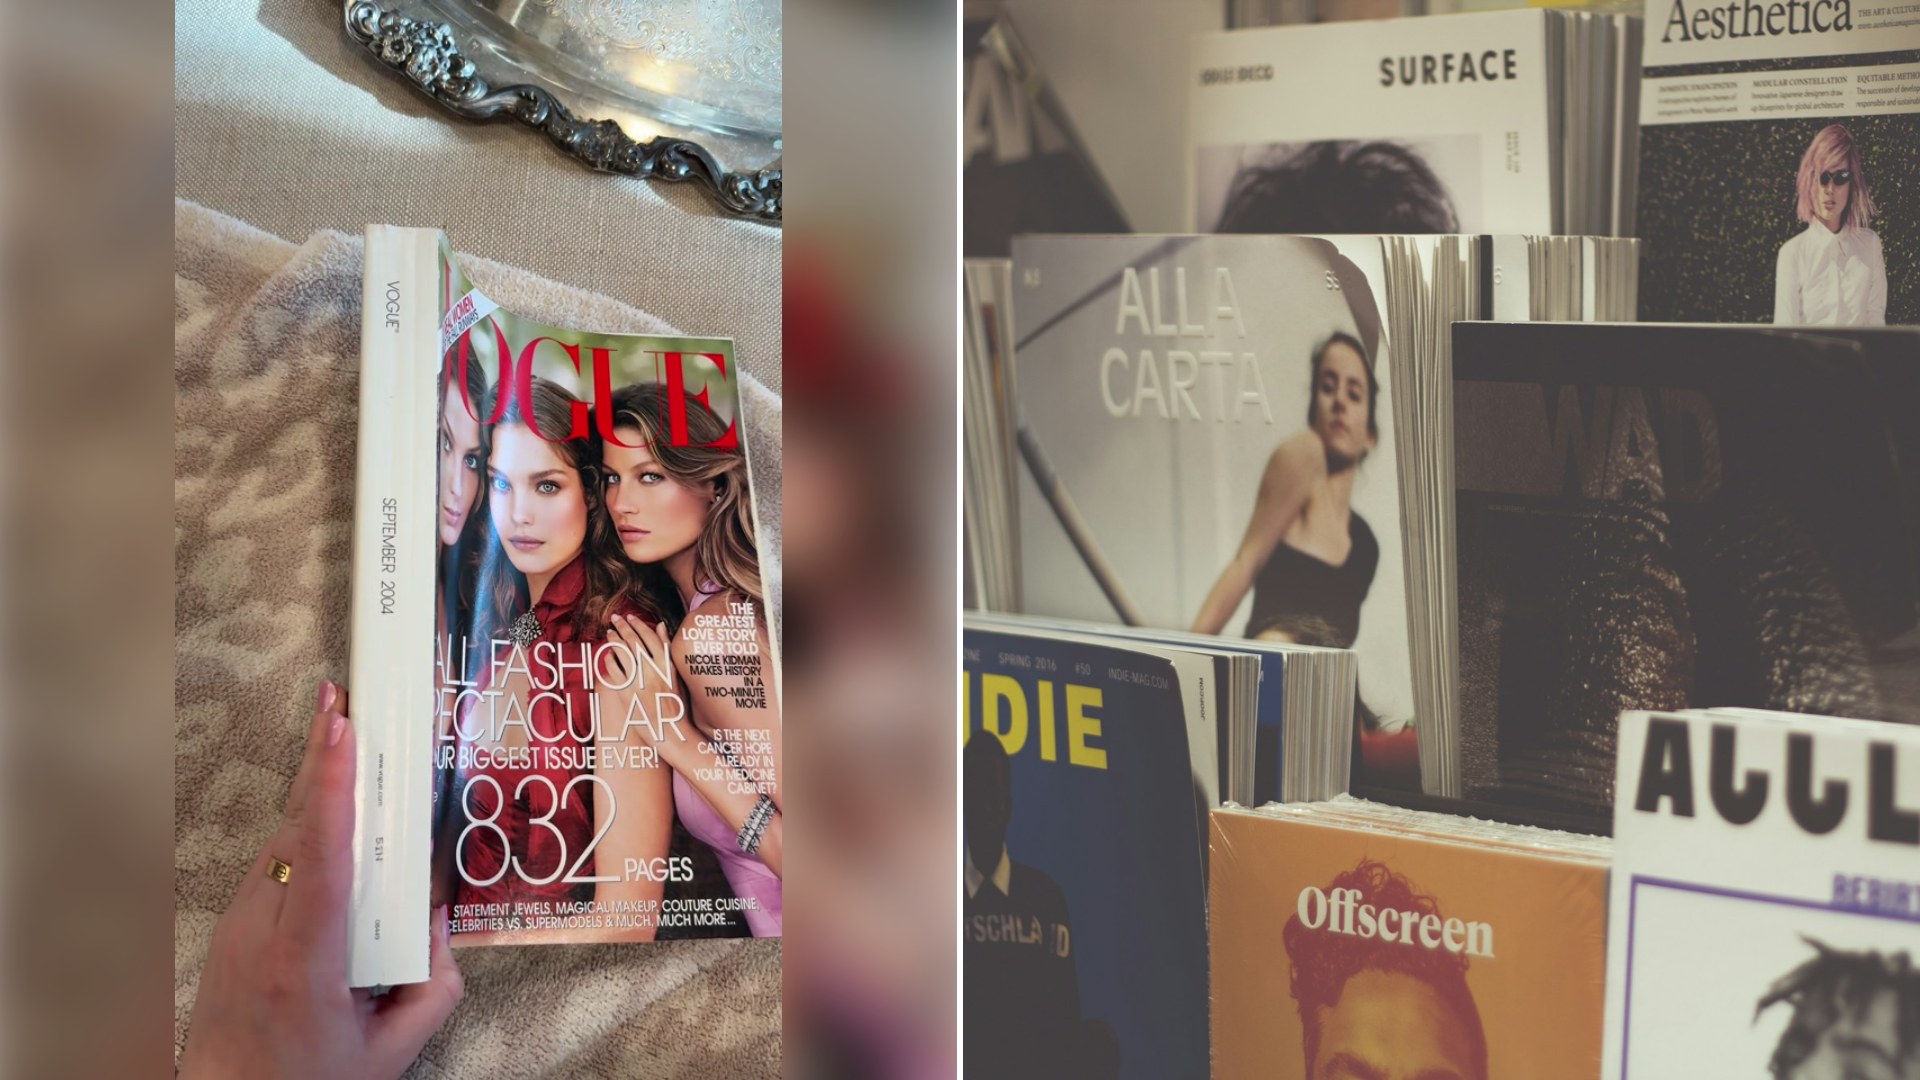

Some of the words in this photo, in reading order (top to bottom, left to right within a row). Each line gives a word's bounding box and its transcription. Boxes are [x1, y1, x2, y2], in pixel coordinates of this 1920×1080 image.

[1661, 0, 1853, 43] Aesthetica
[1379, 49, 1518, 87] SURFACE
[1789, 76, 1847, 86] CONSTELLATION
[1856, 73, 1895, 83] EQUITABLE
[386, 281, 401, 328] VOGUE
[453, 294, 475, 323] WOMEN
[444, 257, 738, 450] OGUE
[1101, 347, 1273, 424] CARTA
[381, 497, 397, 573] SEPTEMBER
[381, 581, 395, 614] 2004
[730, 603, 754, 616] THE
[695, 615, 756, 629] GREATEST
[682, 627, 715, 641] LOVE
[717, 628, 757, 642] STORY
[693, 640, 723, 654] EVER
[725, 641, 759, 655] TOLD
[491, 639, 674, 690] FASHION
[685, 655, 719, 665] NICOLE
[722, 655, 761, 666] KIDMAN
[690, 665, 722, 676] MAKES
[724, 665, 762, 677] HISTORY
[998, 653, 1031, 668] SPRING
[1035, 657, 1057, 671] 2016
[1075, 662, 1091, 676] #50
[1108, 667, 1169, 690] INDIE-MAG.COM
[743, 677, 755, 687] IN
[756, 677, 765, 687] A
[705, 687, 766, 698] TWO-MINUTE
[736, 698, 767, 709] MOVIE
[963, 670, 1108, 770] DIE
[713, 728, 723, 741] IS
[723, 728, 742, 741] THE
[744, 729, 771, 741] NEXT
[697, 742, 743, 754] CANCER
[744, 742, 772, 754] HOPE
[435, 746, 455, 770] UR
[460, 747, 541, 770] BIGGEST
[545, 747, 597, 770] ISSUE
[603, 747, 658, 770] EVER!
[714, 755, 760, 767] ALREADY
[763, 755, 774, 767] IN
[693, 768, 723, 781] YOUR
[725, 768, 776, 781] MEDICINE
[727, 781, 777, 794] CABINET?
[455, 774, 621, 887] 832
[624, 857, 694, 883] PAGES
[453, 903, 510, 918] STATEMENT
[512, 902, 553, 917] JEWELS,
[556, 901, 609, 914] MAGICAL
[612, 899, 659, 913] MAKEUP,
[662, 898, 713, 912] COUTURE
[716, 897, 760, 912] CUISINE,
[448, 918, 503, 933] CELEBRITIES
[506, 917, 523, 930] VS.
[526, 915, 603, 929] SUPERMODELS
[605, 916, 613, 927] &
[616, 914, 654, 928] MUCH,
[657, 914, 691, 927] MUCH
[1297, 886, 1495, 958] Offscreen
